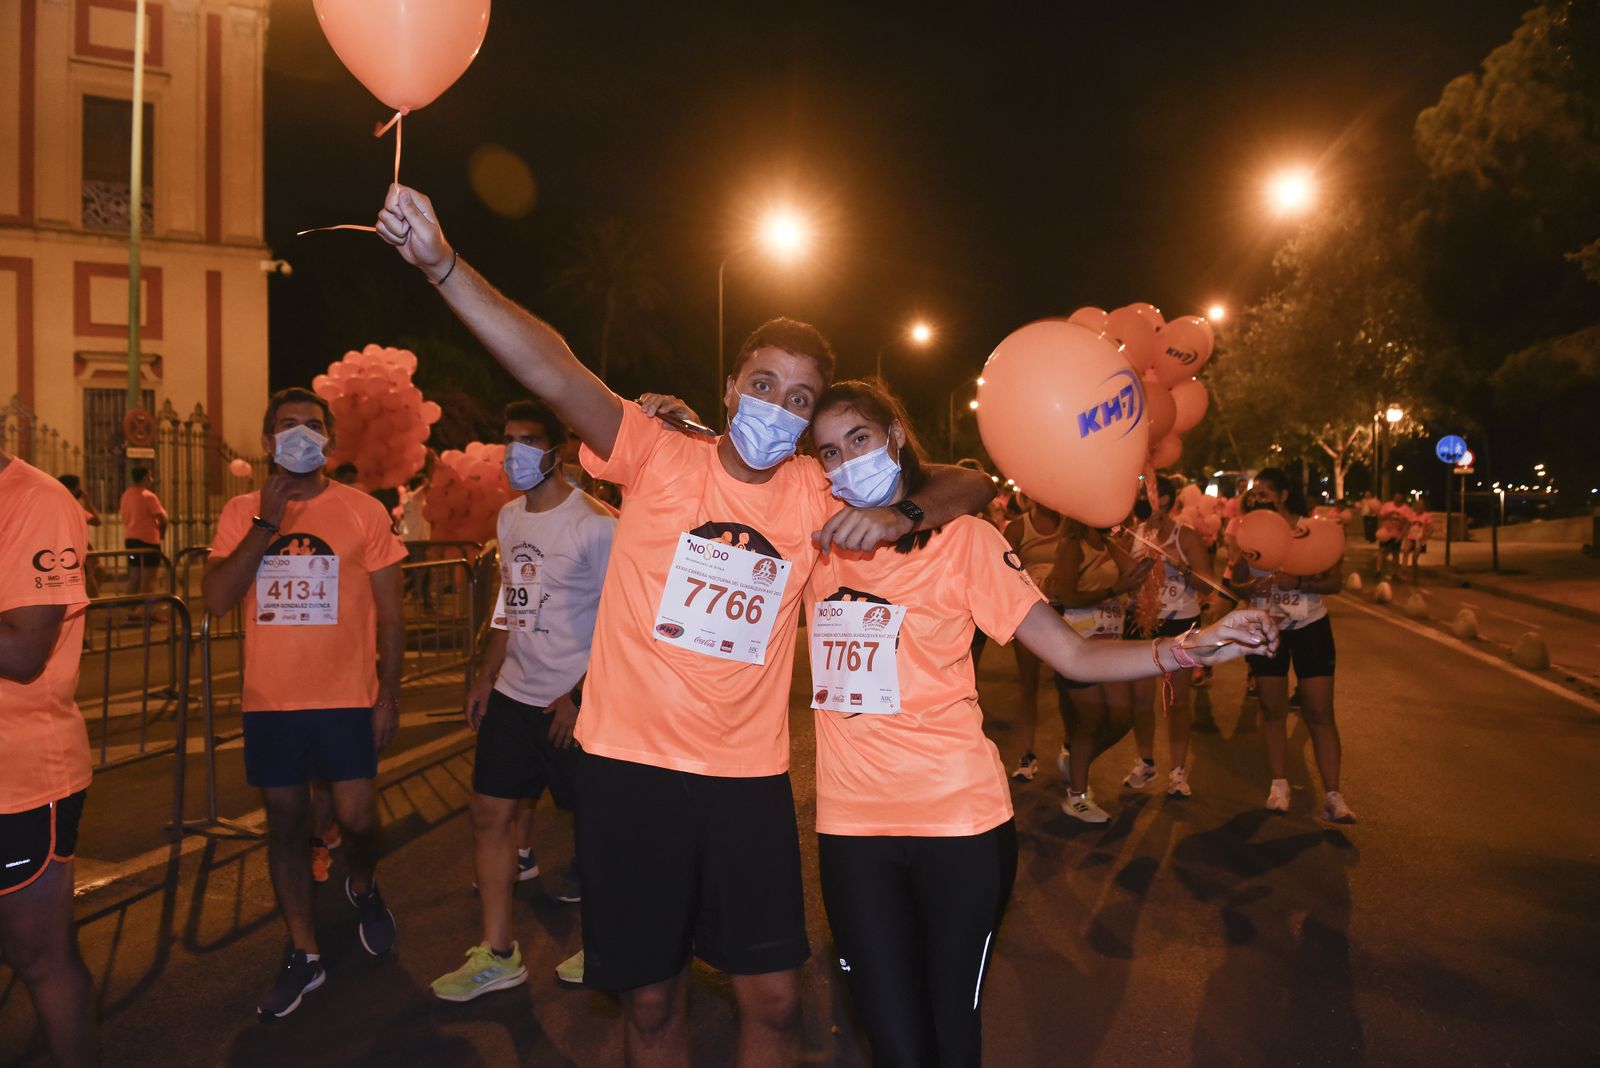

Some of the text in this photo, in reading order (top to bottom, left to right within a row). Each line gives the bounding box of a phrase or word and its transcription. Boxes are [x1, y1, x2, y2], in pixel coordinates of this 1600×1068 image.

[267, 580, 327, 600] 4134
[684, 576, 765, 625] 7766
[823, 641, 879, 672] 7767
